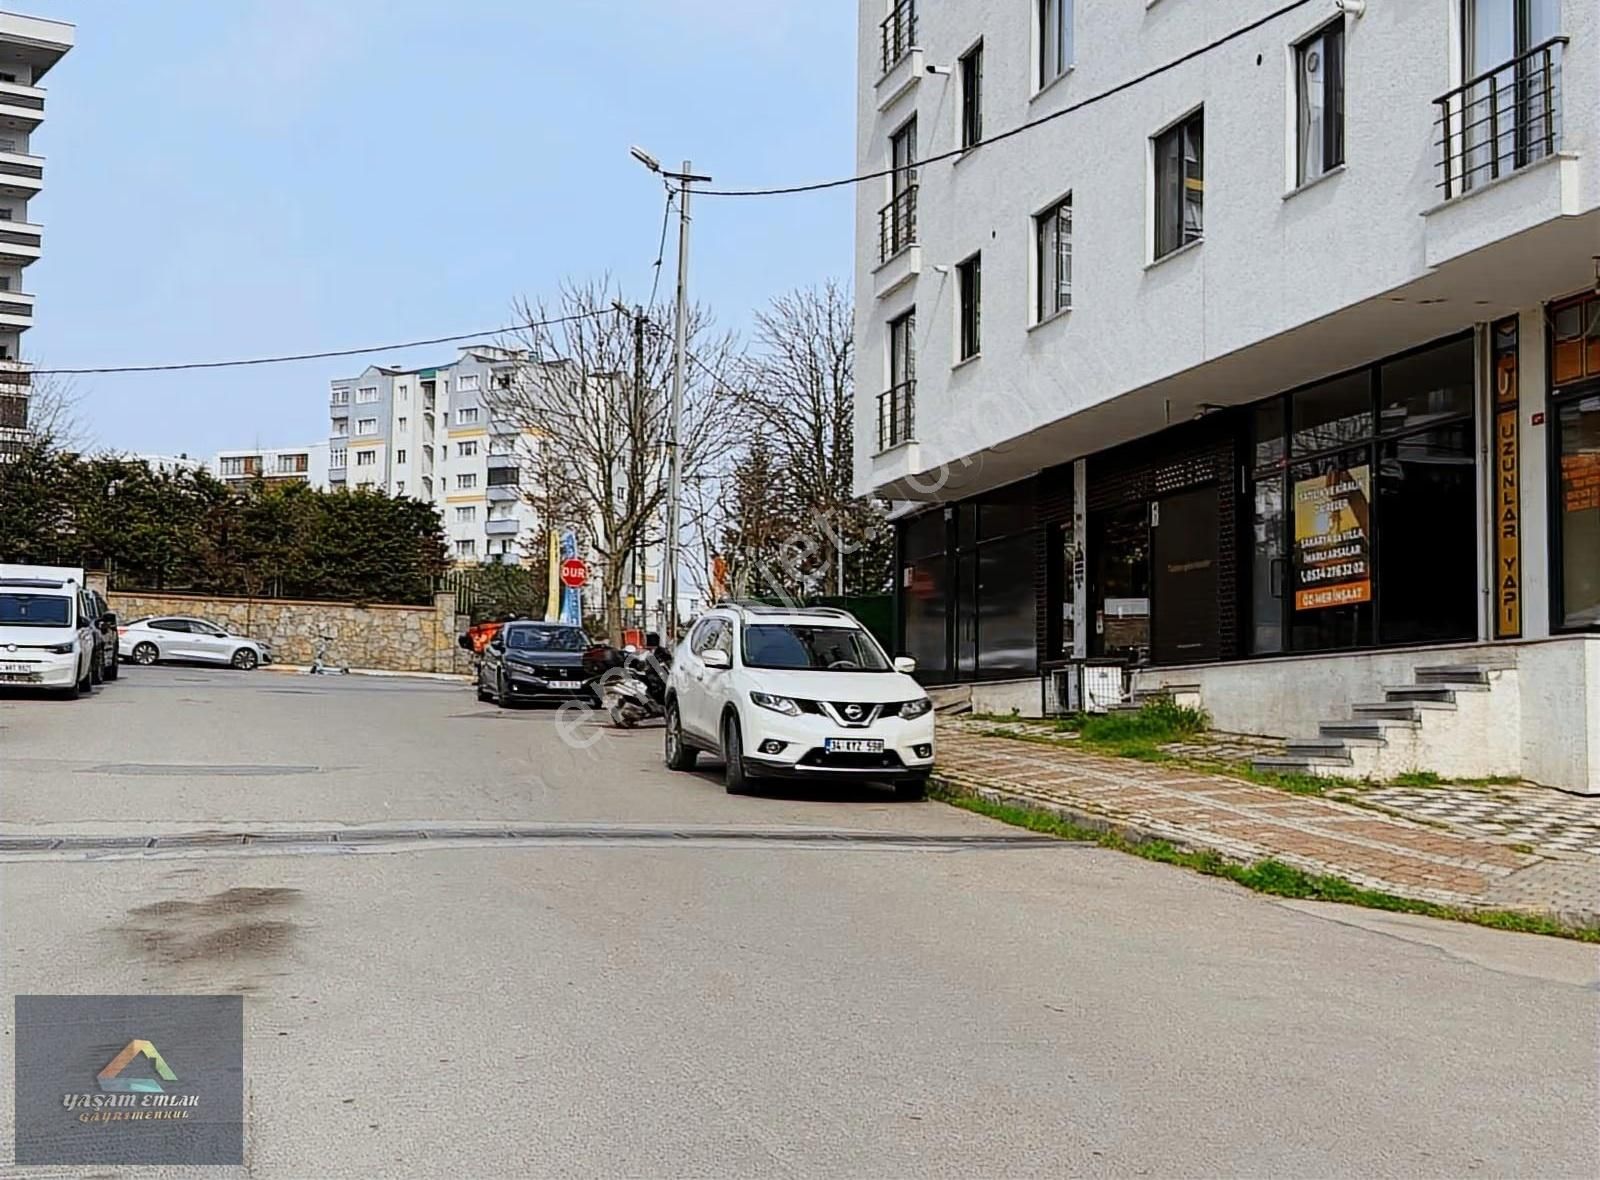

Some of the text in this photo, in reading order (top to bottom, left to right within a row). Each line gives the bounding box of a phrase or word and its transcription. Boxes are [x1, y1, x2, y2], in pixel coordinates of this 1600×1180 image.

[562, 567, 585, 580] DUR
[1501, 423, 1517, 623] UZUNLAR YAPI
